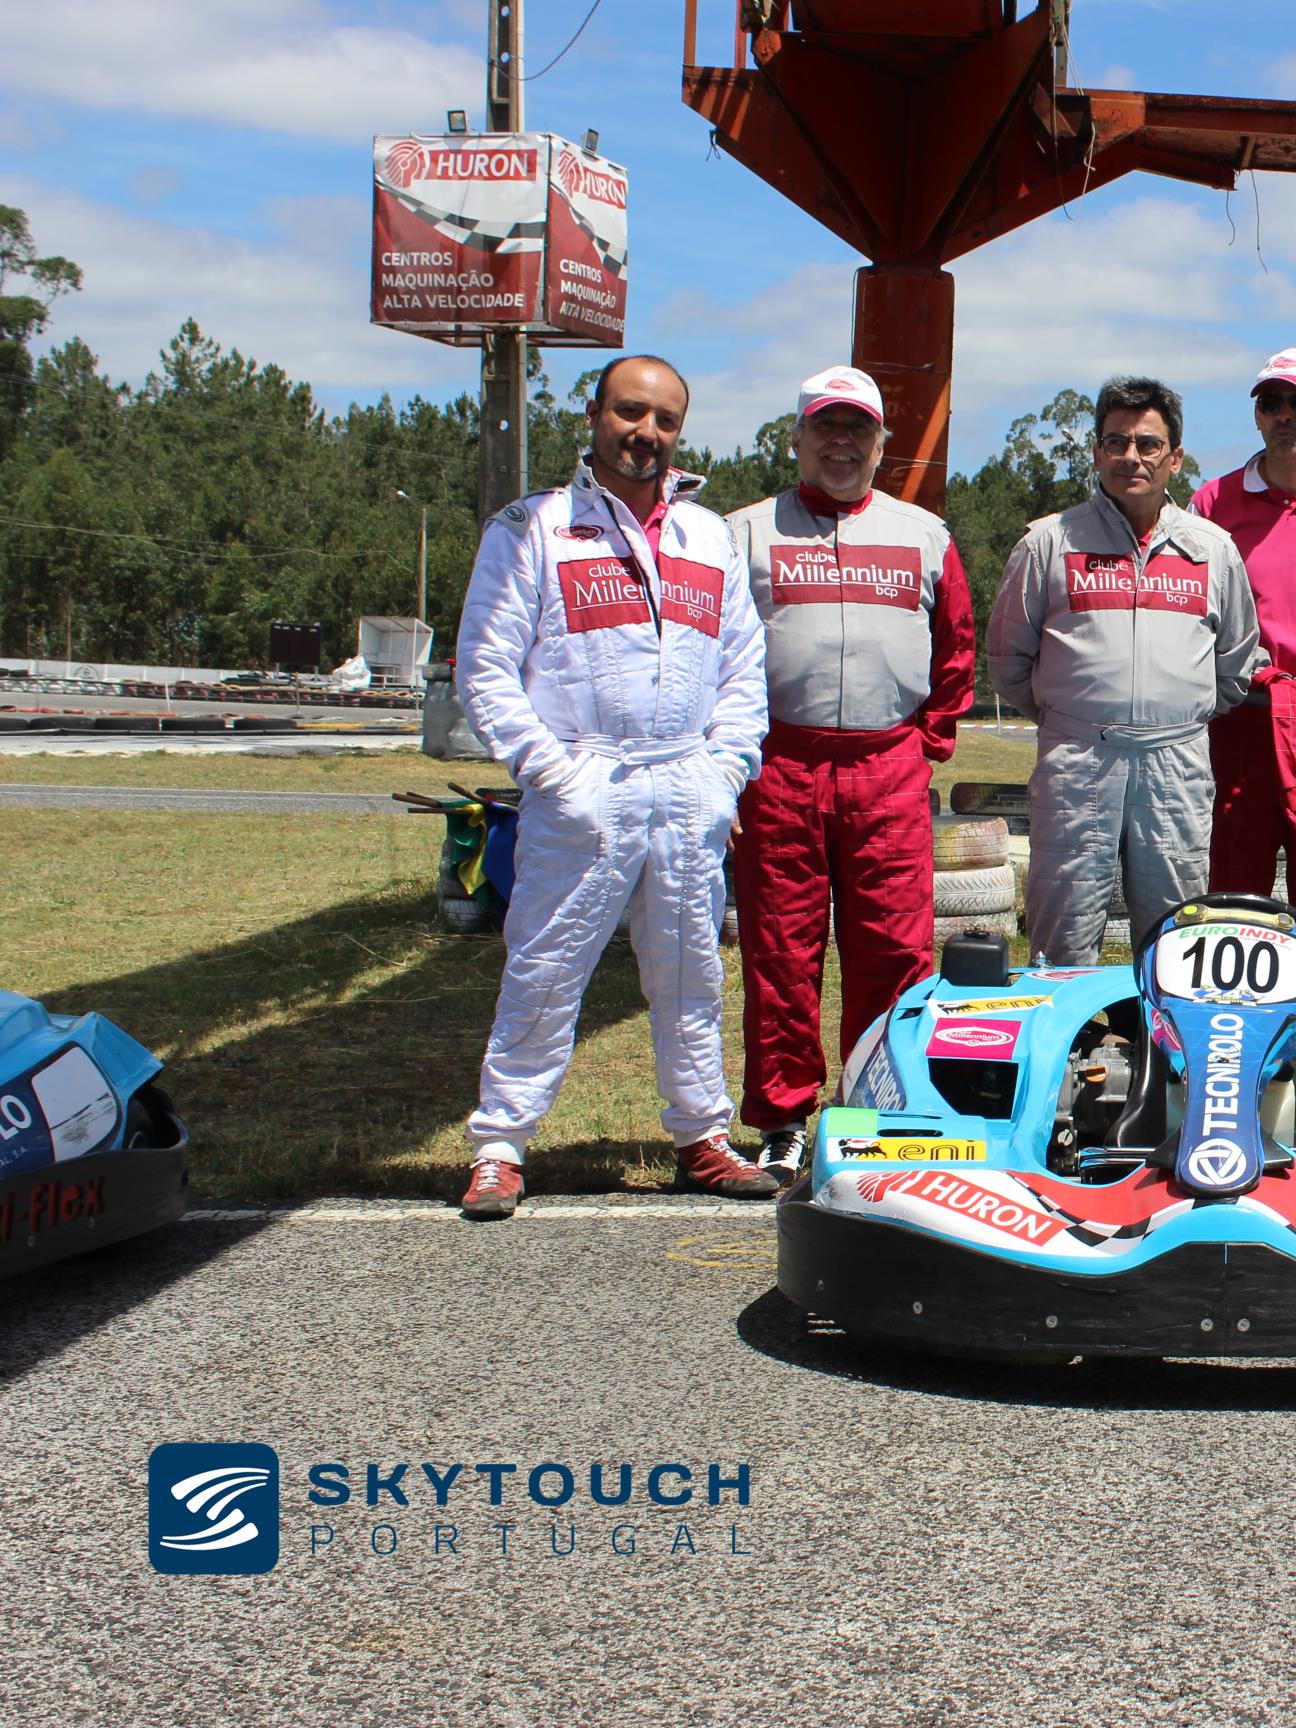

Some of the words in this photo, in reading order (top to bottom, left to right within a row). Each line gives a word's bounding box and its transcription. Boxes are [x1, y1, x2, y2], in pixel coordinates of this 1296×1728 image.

[436, 152, 528, 178] HURON
[381, 251, 453, 266] CENTROS
[381, 270, 494, 291] MAQUINAÇÃO
[559, 258, 602, 283] CENTROS
[383, 294, 423, 309] ALTA
[428, 292, 525, 308] VELOCIDADE
[796, 551, 837, 564] clube
[1089, 559, 1129, 572] clube
[589, 562, 632, 578] clube
[775, 559, 914, 588] Millennium
[1070, 568, 1203, 595] Millennium
[875, 585, 898, 599] bcp
[1166, 592, 1188, 606] bcp
[687, 604, 702, 622] bcp
[1179, 926, 1291, 945] EUROINDY
[1182, 936, 1280, 994] 100
[1202, 1013, 1244, 1137] TECNIROLO
[898, 1140, 976, 1161] eni
[920, 1172, 1052, 1239] HURON
